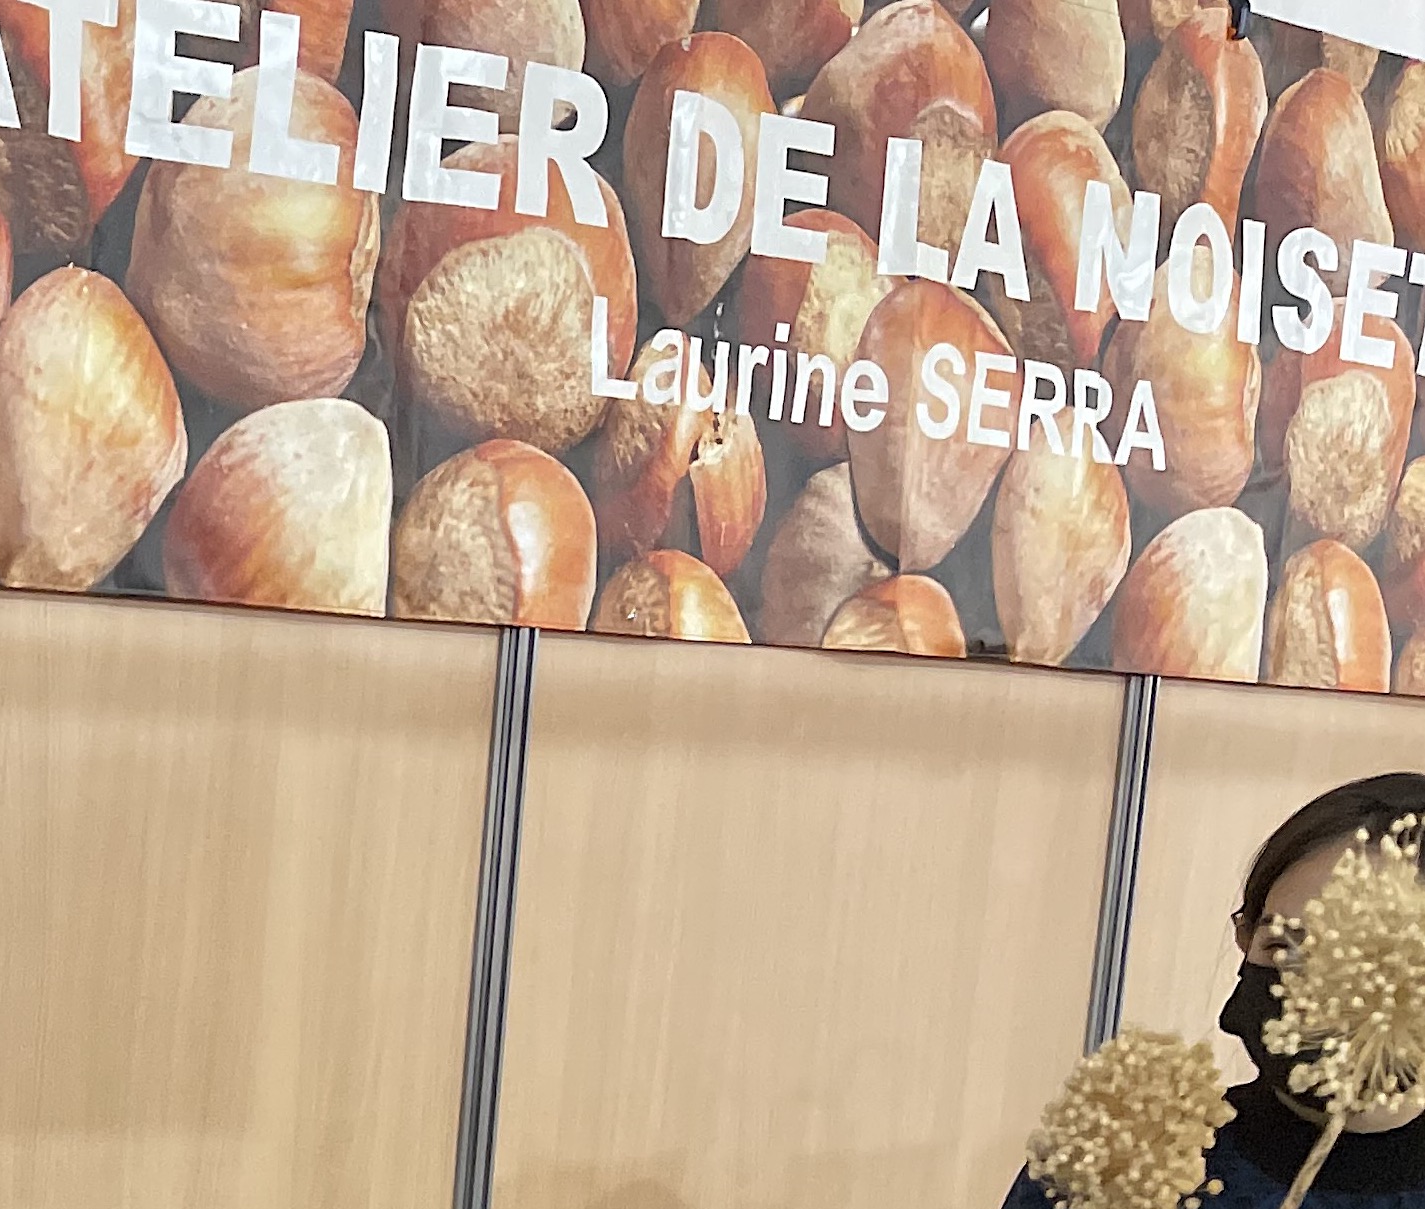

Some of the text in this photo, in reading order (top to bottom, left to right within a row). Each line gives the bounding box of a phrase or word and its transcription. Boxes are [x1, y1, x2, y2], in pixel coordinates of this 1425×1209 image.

[662, 90, 836, 263] DE
[877, 136, 1030, 302] LA
[591, 296, 1166, 472] Laurine SERRA
